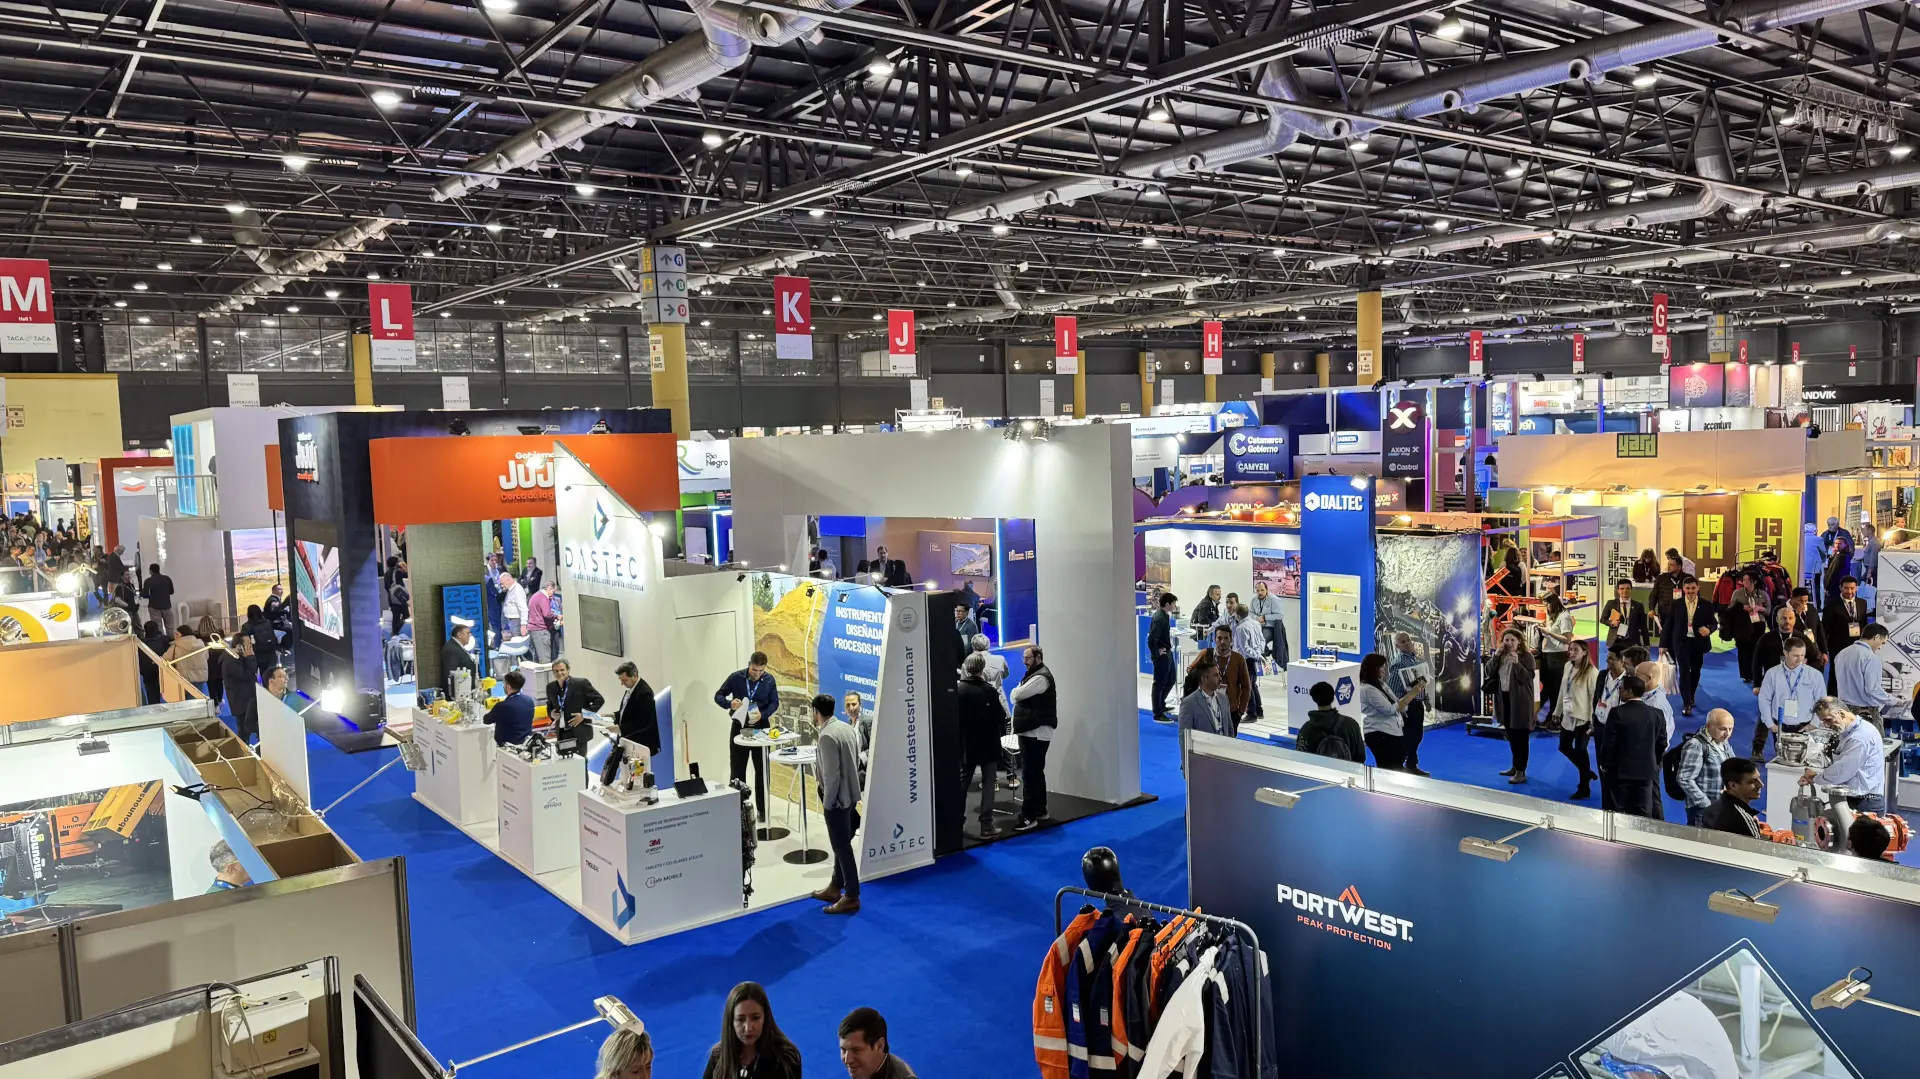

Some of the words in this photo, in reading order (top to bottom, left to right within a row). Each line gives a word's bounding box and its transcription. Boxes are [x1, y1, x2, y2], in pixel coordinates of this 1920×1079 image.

[0, 276, 47, 312] M
[381, 298, 403, 330] L
[782, 291, 804, 324] K
[1656, 304, 1665, 328] G
[895, 322, 909, 347] J
[1064, 330, 1069, 350] I
[1208, 334, 1219, 353] H
[1473, 340, 1480, 356] F
[1576, 343, 1581, 358] E
[1741, 347, 1746, 360] C
[1794, 350, 1799, 362] B
[1802, 391, 1837, 399] ANDVIK
[1703, 420, 1732, 431] accenture
[1247, 436, 1284, 444] Catamarca
[1618, 434, 1656, 457] yard
[1247, 444, 1279, 454] Gobierno
[706, 460, 728, 468] Negro
[1237, 461, 1270, 472] CAMYEN
[1396, 463, 1419, 471] Castrol
[499, 459, 560, 490] JUJ
[501, 493, 526, 501] Cerca
[1321, 494, 1363, 511] DALTEC
[1200, 544, 1239, 561] DALTEC
[565, 547, 638, 580] DASTEC
[834, 637, 872, 653] PROCESOS
[905, 645, 918, 804] www.dastecsrl.com.ar
[118, 792, 146, 828] bounous
[649, 838, 661, 847] 3M
[869, 836, 925, 858] DASTEC
[1297, 914, 1324, 930] PEAK
[1326, 923, 1392, 951] PROTECTION
